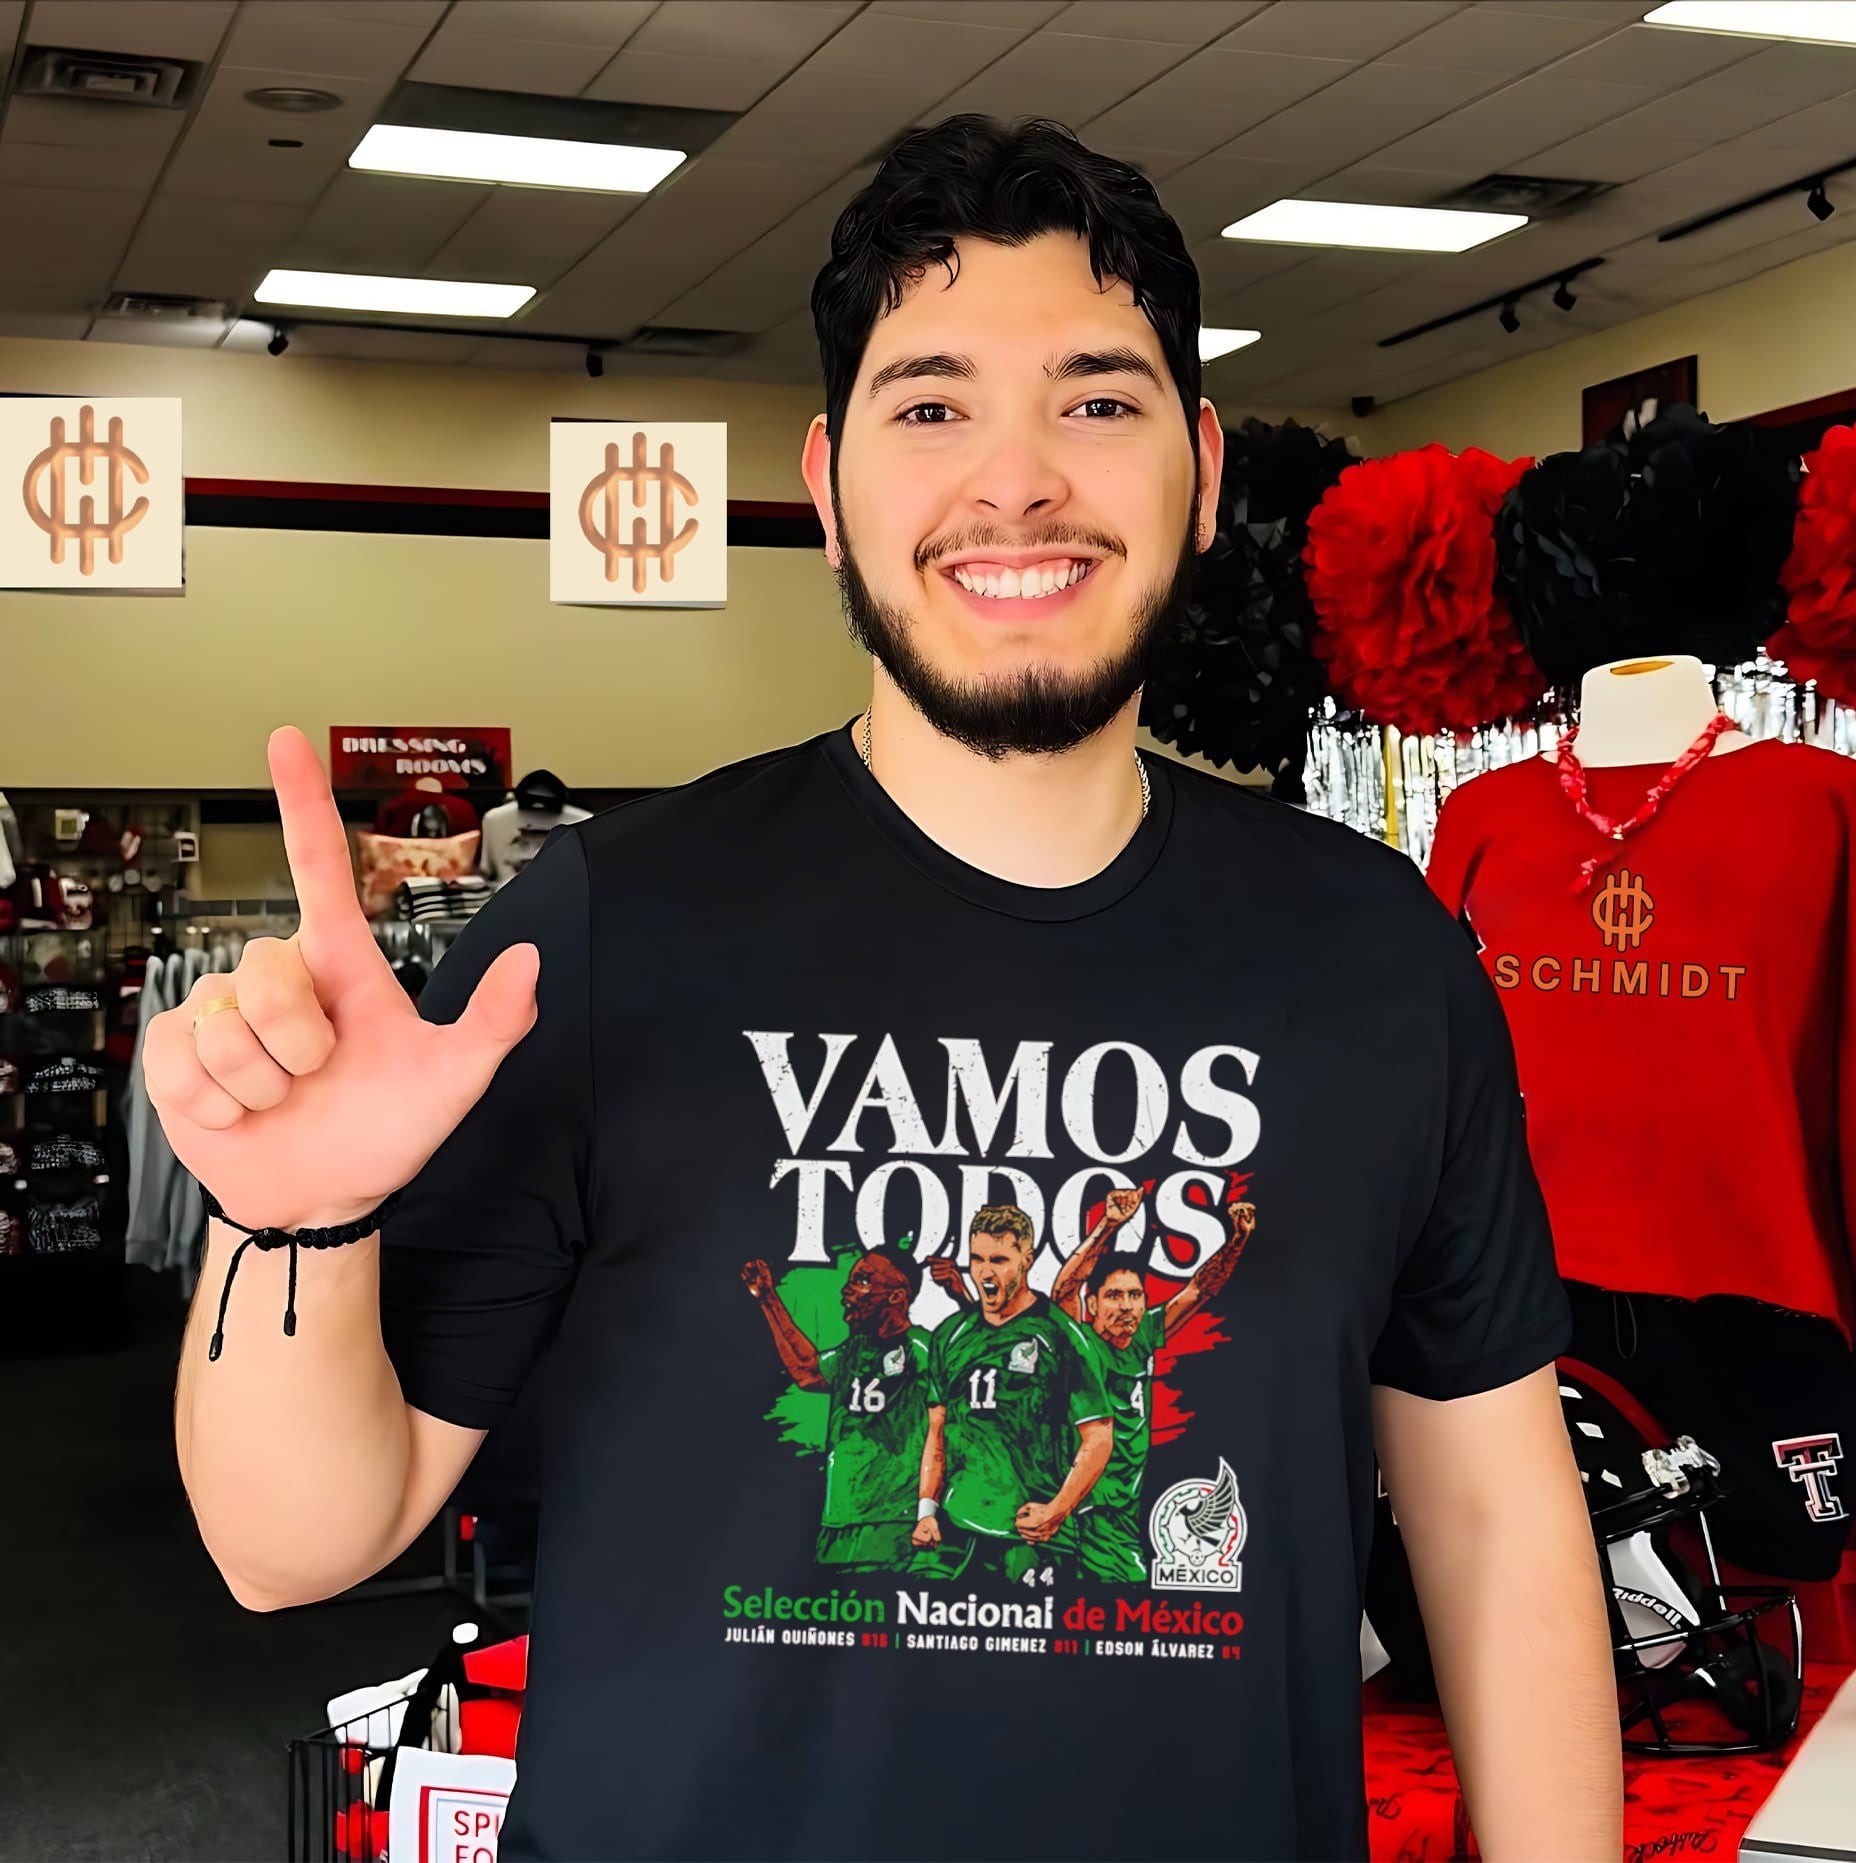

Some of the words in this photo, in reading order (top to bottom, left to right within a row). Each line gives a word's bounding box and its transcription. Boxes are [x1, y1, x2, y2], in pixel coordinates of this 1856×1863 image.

[342, 737, 467, 754] DRESSING
[396, 758, 487, 775] ROOMS
[1494, 954, 1747, 1000] SCHMIDT
[742, 1030, 1261, 1167] VAMOS
[849, 1377, 885, 1412] 16
[969, 1368, 997, 1409] 11
[1159, 1564, 1234, 1585] MÉXICO
[723, 1585, 885, 1623] Selección
[896, 1590, 1054, 1629] Nacional
[1063, 1597, 1106, 1631] de
[1115, 1597, 1244, 1636] México
[724, 1624, 776, 1644] JULIÁN
[782, 1626, 856, 1647] QUIÑONES
[906, 1633, 979, 1650] SANTIAGO
[985, 1636, 1047, 1654] GIMENEZ
[1095, 1639, 1144, 1657] EDSON
[1151, 1638, 1214, 1659] ÁLVAREZ
